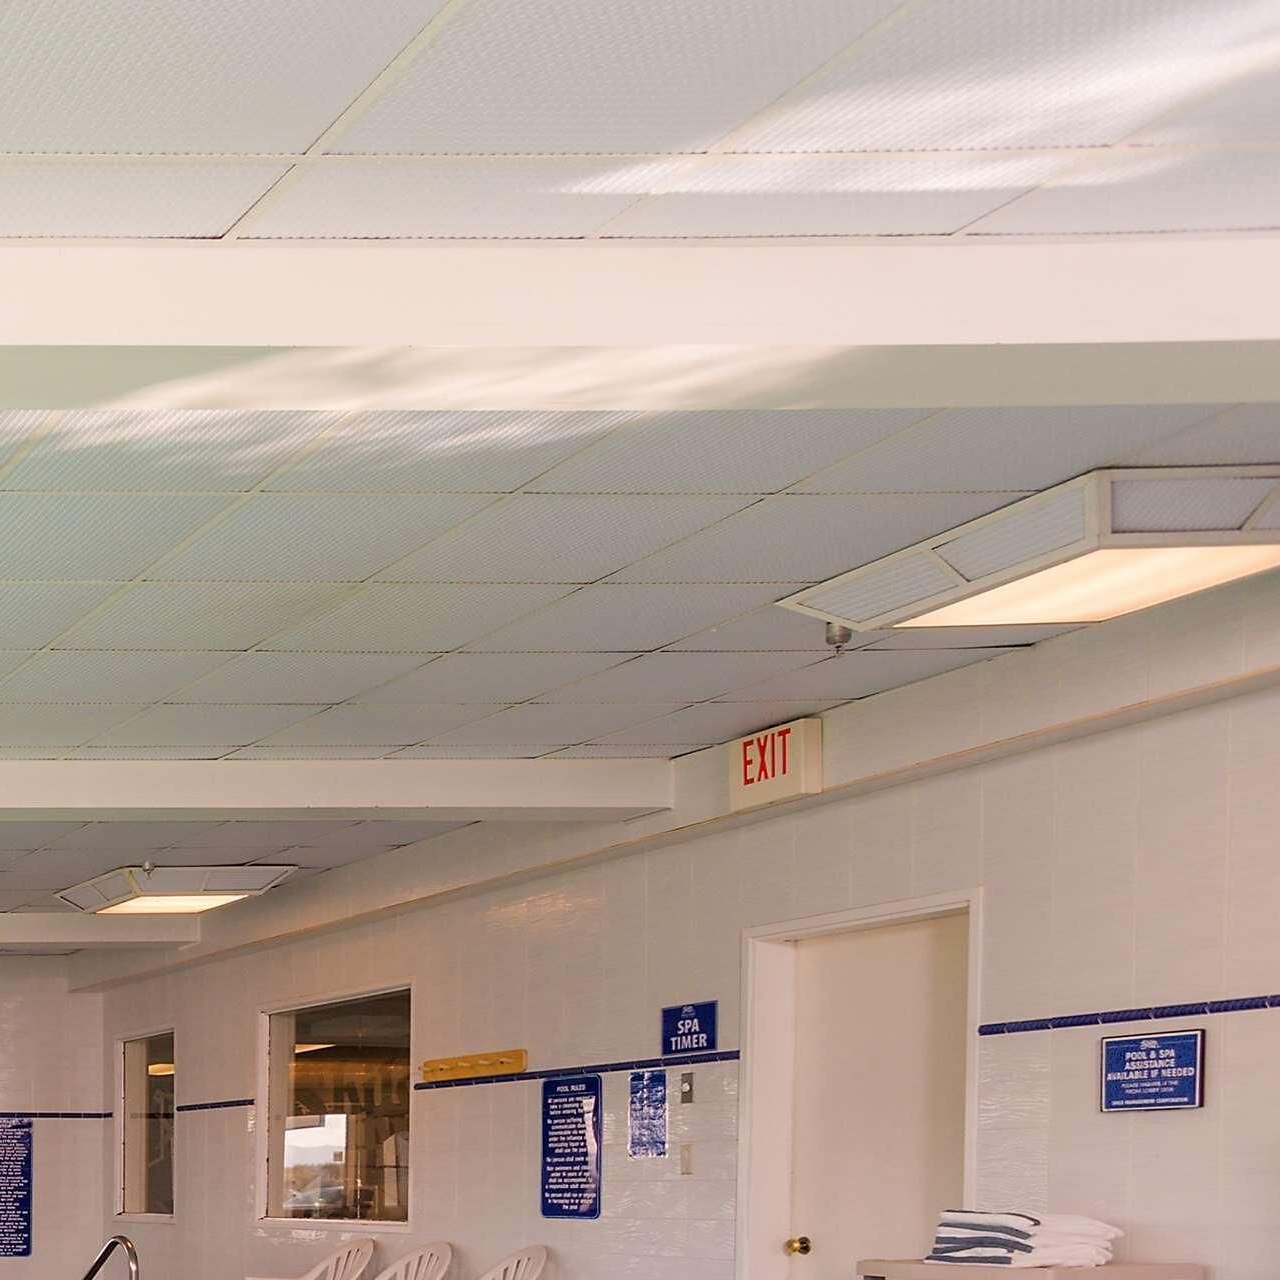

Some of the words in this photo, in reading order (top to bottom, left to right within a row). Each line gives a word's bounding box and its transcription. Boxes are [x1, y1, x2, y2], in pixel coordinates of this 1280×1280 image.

[742, 728, 791, 785] EXIT
[677, 1018, 699, 1034] SPA
[670, 1033, 707, 1050] TIMER
[1125, 1051, 1147, 1060] POOL
[1159, 1049, 1175, 1059] SPA
[1124, 1059, 1175, 1070] ASSISTANCE
[1107, 1070, 1149, 1080] AVAILABLE
[1151, 1069, 1159, 1078] IF
[1162, 1067, 1195, 1077] NEEDED
